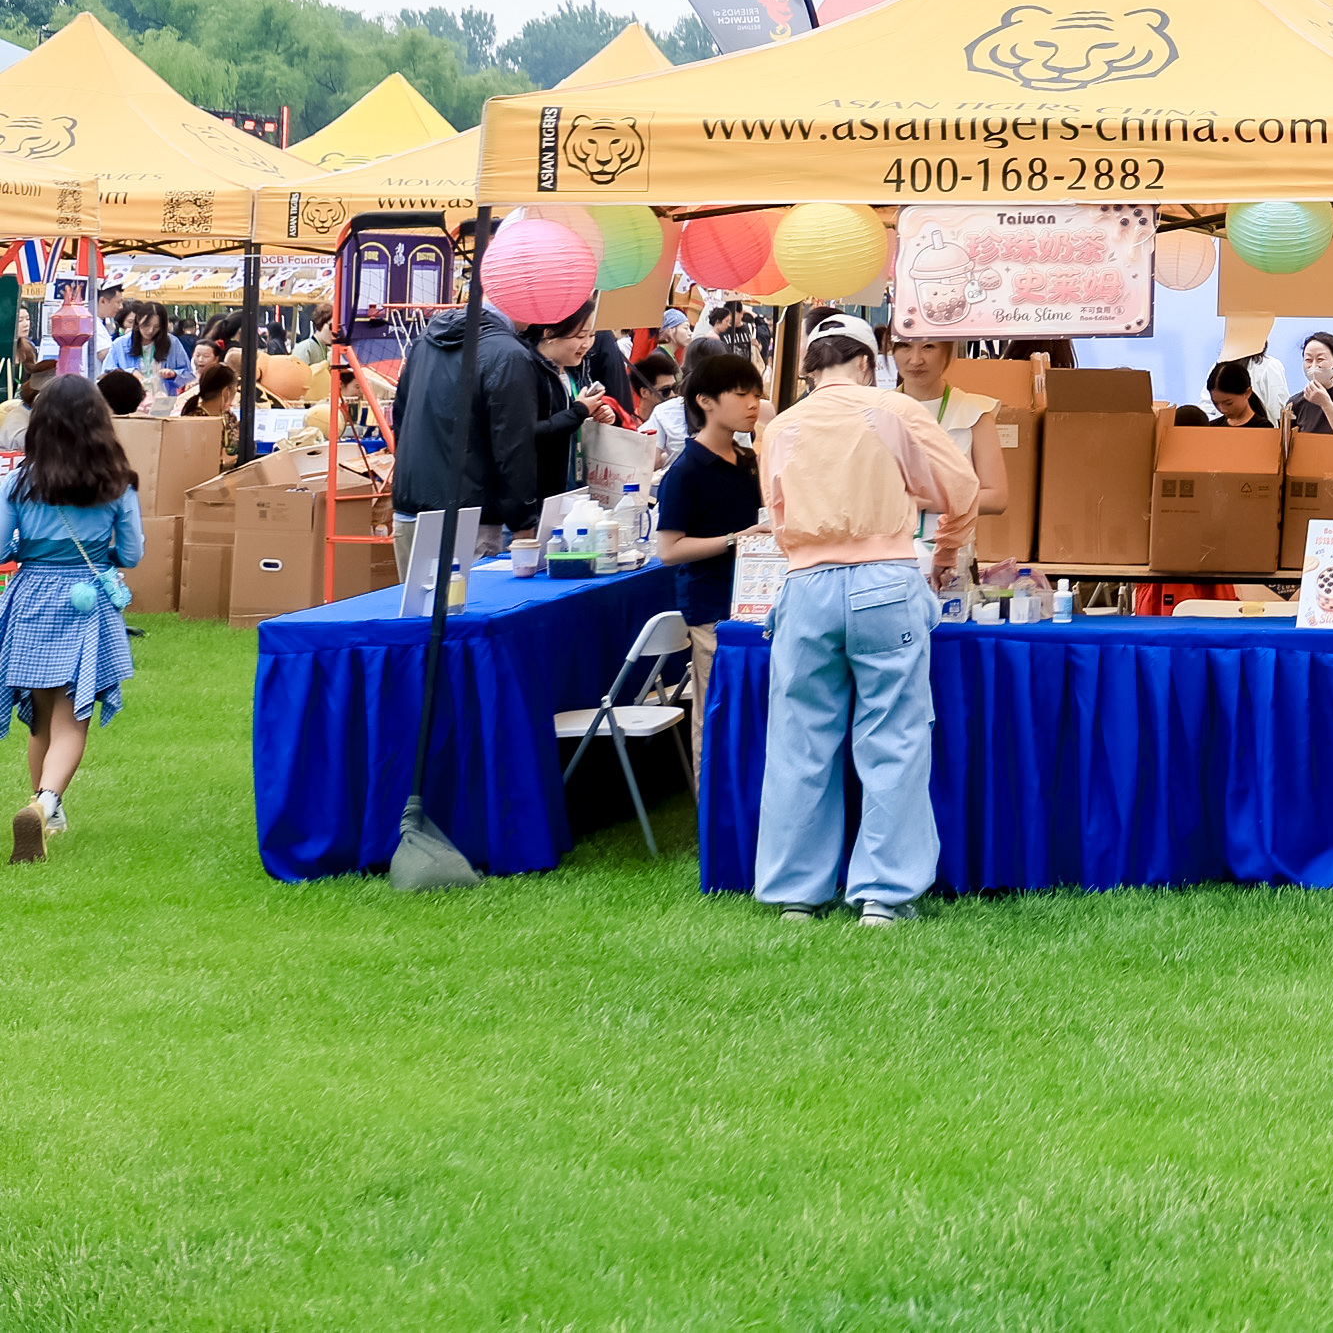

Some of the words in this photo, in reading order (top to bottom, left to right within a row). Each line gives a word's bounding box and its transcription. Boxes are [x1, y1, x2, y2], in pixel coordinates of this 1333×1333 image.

[815, 99, 940, 110] ASIAN
[953, 101, 1081, 113] TIGERS
[1096, 106, 1219, 117] CHINA
[542, 108, 560, 148] TIGERS
[702, 116, 1329, 149] www.asiantigers-china.com
[539, 149, 556, 190] ASIAN
[883, 157, 1165, 193] 400-168-2882
[378, 197, 474, 209] www.as
[997, 212, 1056, 226] Taiwan
[289, 215, 299, 237] ASIAN
[966, 229, 1105, 264] 珍珠奶茶
[1010, 267, 1125, 304] 史莱姆
[993, 308, 1031, 323] Boba
[1034, 307, 1074, 322] Slime
